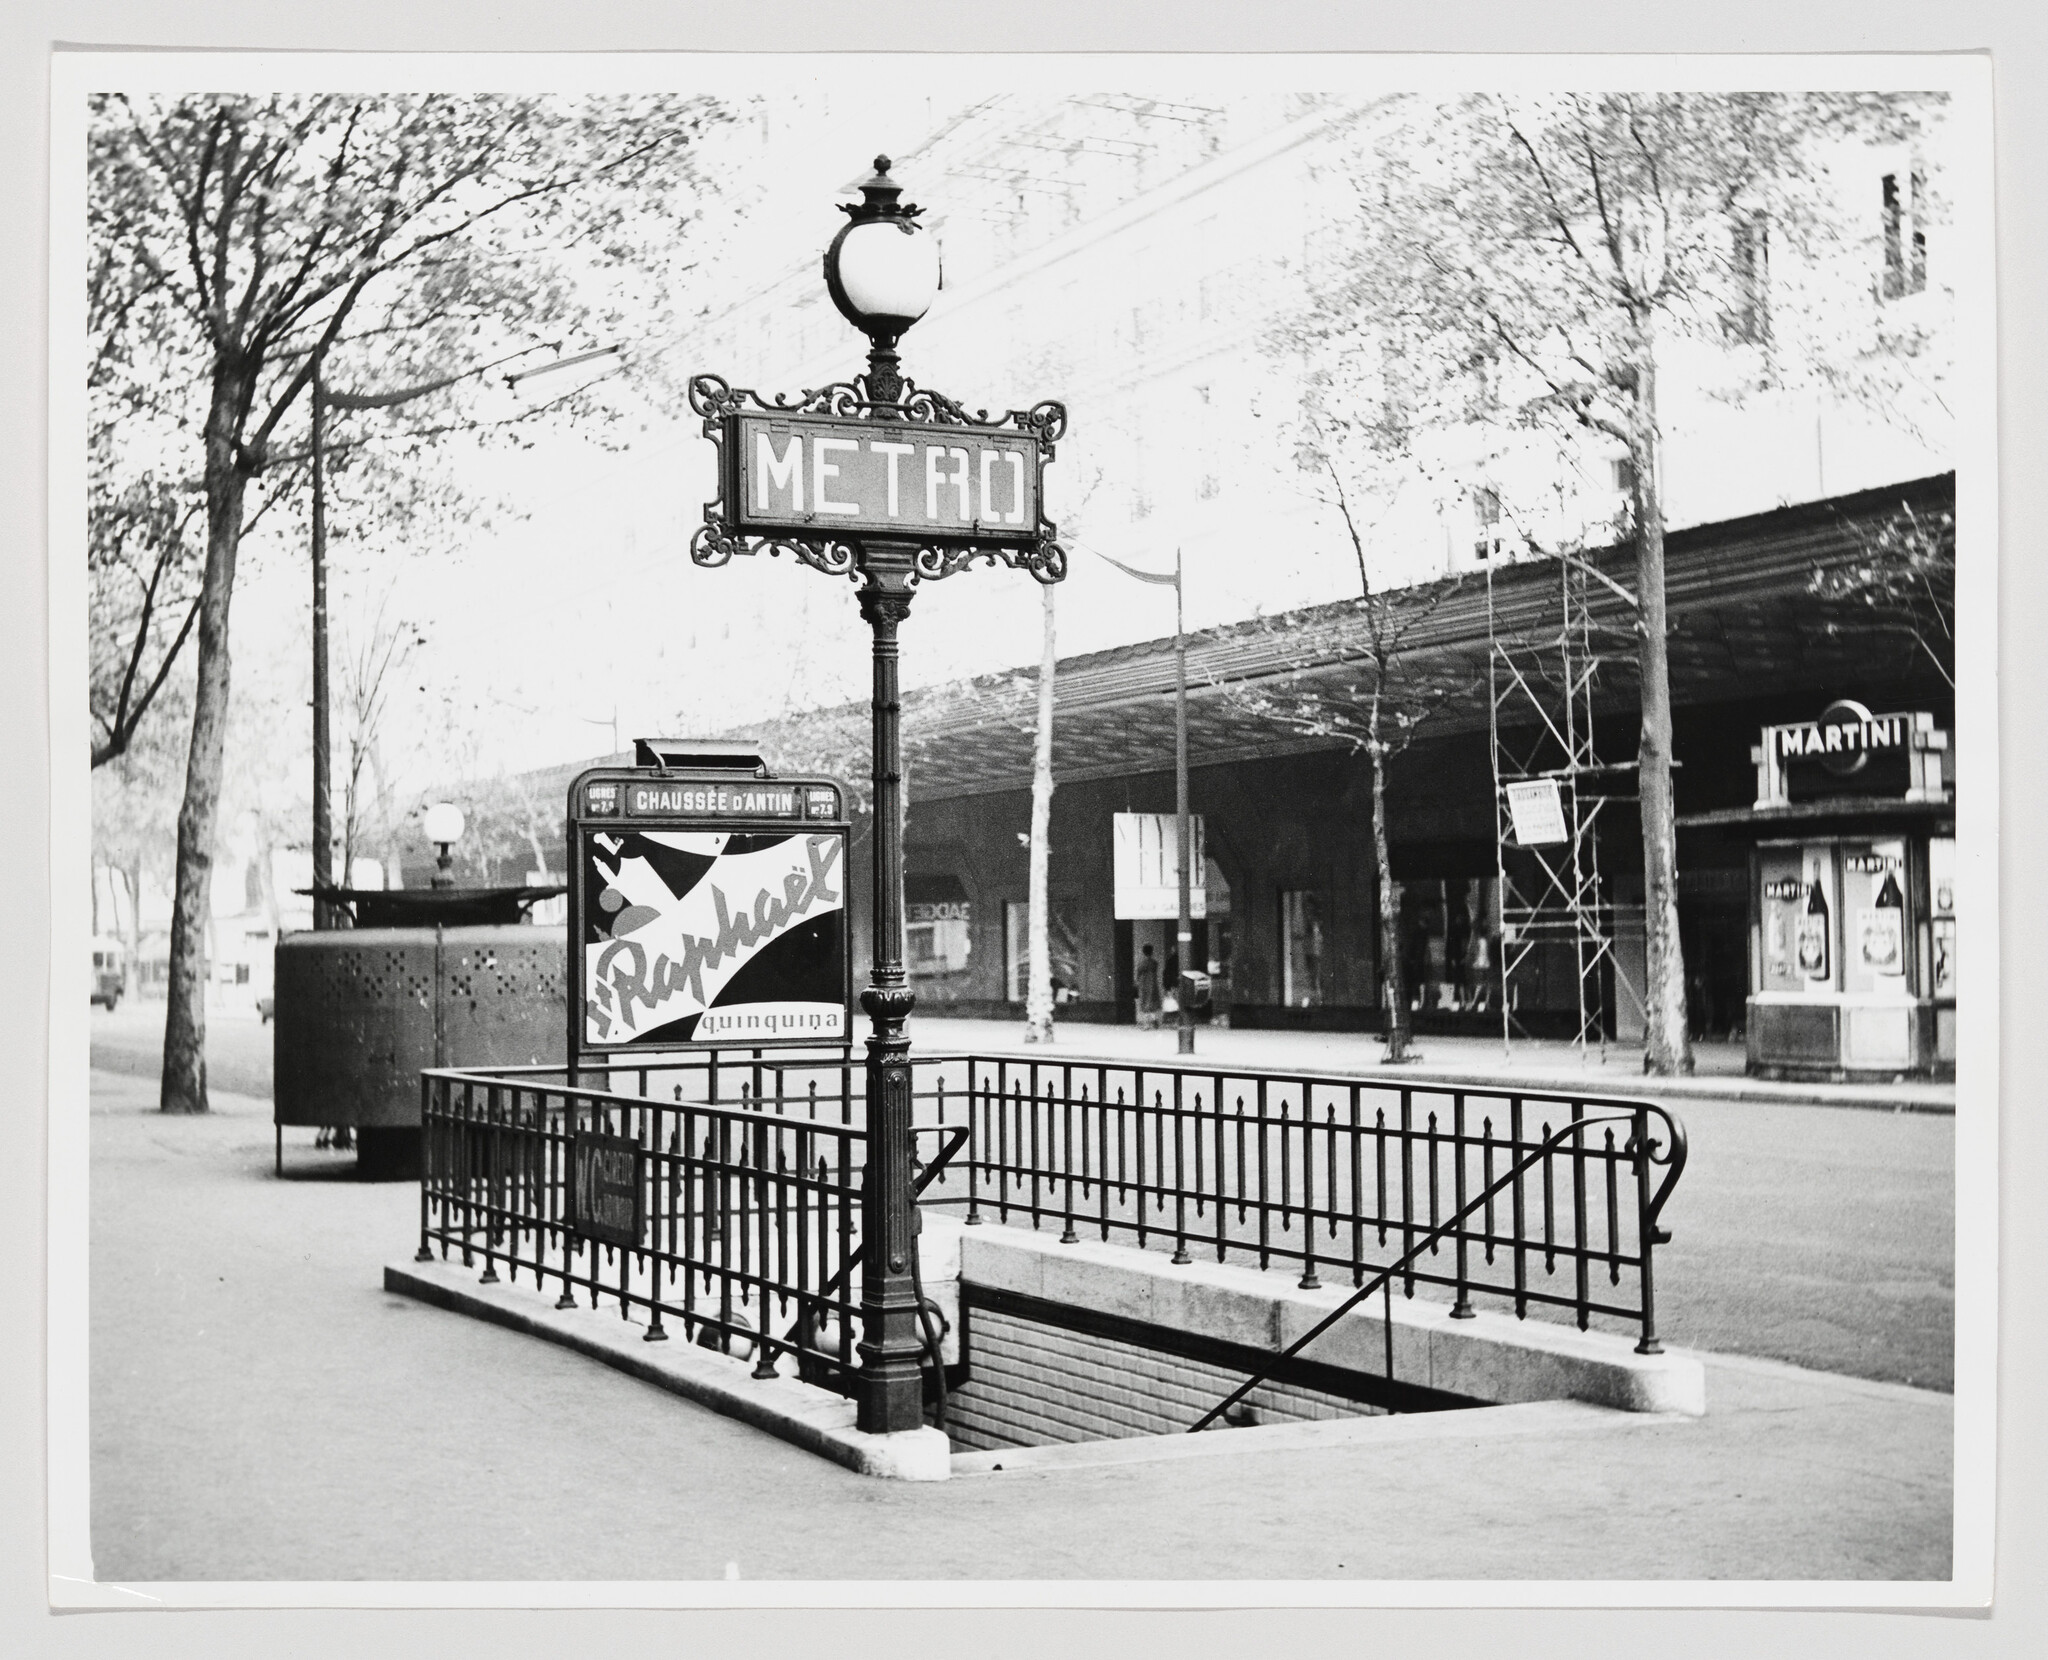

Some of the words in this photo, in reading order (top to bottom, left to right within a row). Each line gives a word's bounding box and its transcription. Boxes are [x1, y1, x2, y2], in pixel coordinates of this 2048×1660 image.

[756, 432, 1025, 524] METRO
[1781, 718, 1902, 757] MARTINI
[588, 787, 616, 800] LIGNES
[636, 789, 728, 811] CHAUSSÉE
[809, 790, 835, 803] LIGNES
[1846, 857, 1900, 873] MARTINI
[596, 835, 843, 1031] Raphaël
[702, 1011, 839, 1034] quinquina
